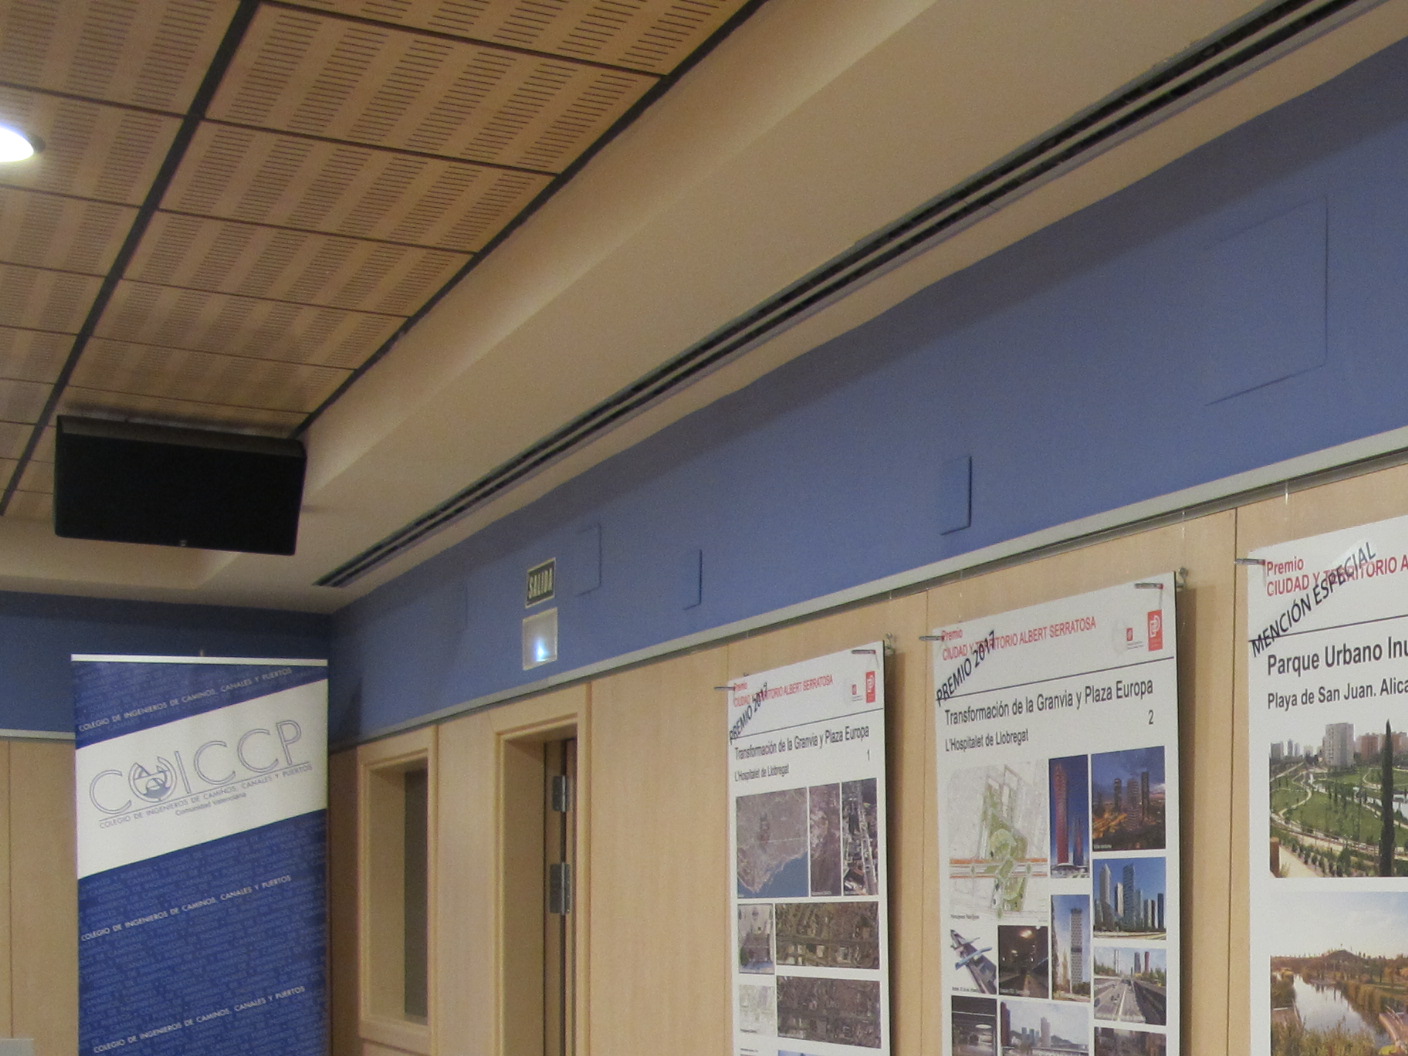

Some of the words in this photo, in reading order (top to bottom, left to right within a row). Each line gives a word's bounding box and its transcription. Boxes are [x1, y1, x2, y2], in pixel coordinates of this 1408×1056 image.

[529, 567, 552, 599] SALIDA
[1267, 556, 1304, 576] Premio
[1252, 593, 1312, 658] MENCIÓN
[1313, 542, 1376, 605] ESPECIAL
[1267, 575, 1309, 597] CIUDAD
[1313, 572, 1320, 583] Y
[942, 643, 968, 661] CIUDAD
[1019, 627, 1048, 646] ALBERT
[1049, 617, 1096, 640] SERRATOSA
[936, 658, 972, 707] PREMIO
[973, 629, 996, 668] 2017
[1268, 652, 1319, 677] Parque
[1325, 643, 1382, 667] Urbano
[79, 718, 109, 732] COLEGIO
[112, 713, 121, 722] DE
[125, 702, 167, 719] INGENIEROS
[170, 699, 179, 707] DE
[221, 678, 252, 693] CANALES
[262, 667, 292, 680] PUERTOS
[945, 701, 1009, 725] Transformación
[1012, 698, 1023, 714] de
[1026, 696, 1033, 712] la
[1037, 691, 1072, 711] Granvia
[1076, 692, 1082, 709] y
[1086, 685, 1112, 703] Plaza
[1116, 679, 1153, 701] Europa
[1268, 692, 1297, 711] Playa
[1301, 689, 1314, 704] de
[1318, 686, 1340, 703] San
[1344, 683, 1376, 700] Juan.
[1149, 710, 1153, 725] 2
[735, 741, 776, 760] Transformación
[778, 740, 786, 752] de
[787, 737, 792, 750] la
[794, 733, 817, 749] Granvia
[820, 736, 823, 748] y
[825, 730, 843, 743] Plaza
[845, 726, 869, 742] Europa
[986, 732, 993, 747] de
[996, 729, 1028, 747] Llobregat
[81, 927, 110, 941] COLEGIO
[113, 924, 122, 932] DE
[125, 911, 168, 927] INGENIEROS
[221, 886, 252, 900] CANALES
[262, 875, 291, 888] PUERTOS
[94, 1039, 125, 1053] COLEGIO
[128, 1035, 137, 1043] DE
[140, 1023, 182, 1039] INGENIEROS
[234, 998, 266, 1012] CANALES
[275, 986, 305, 999] PUERTOS
